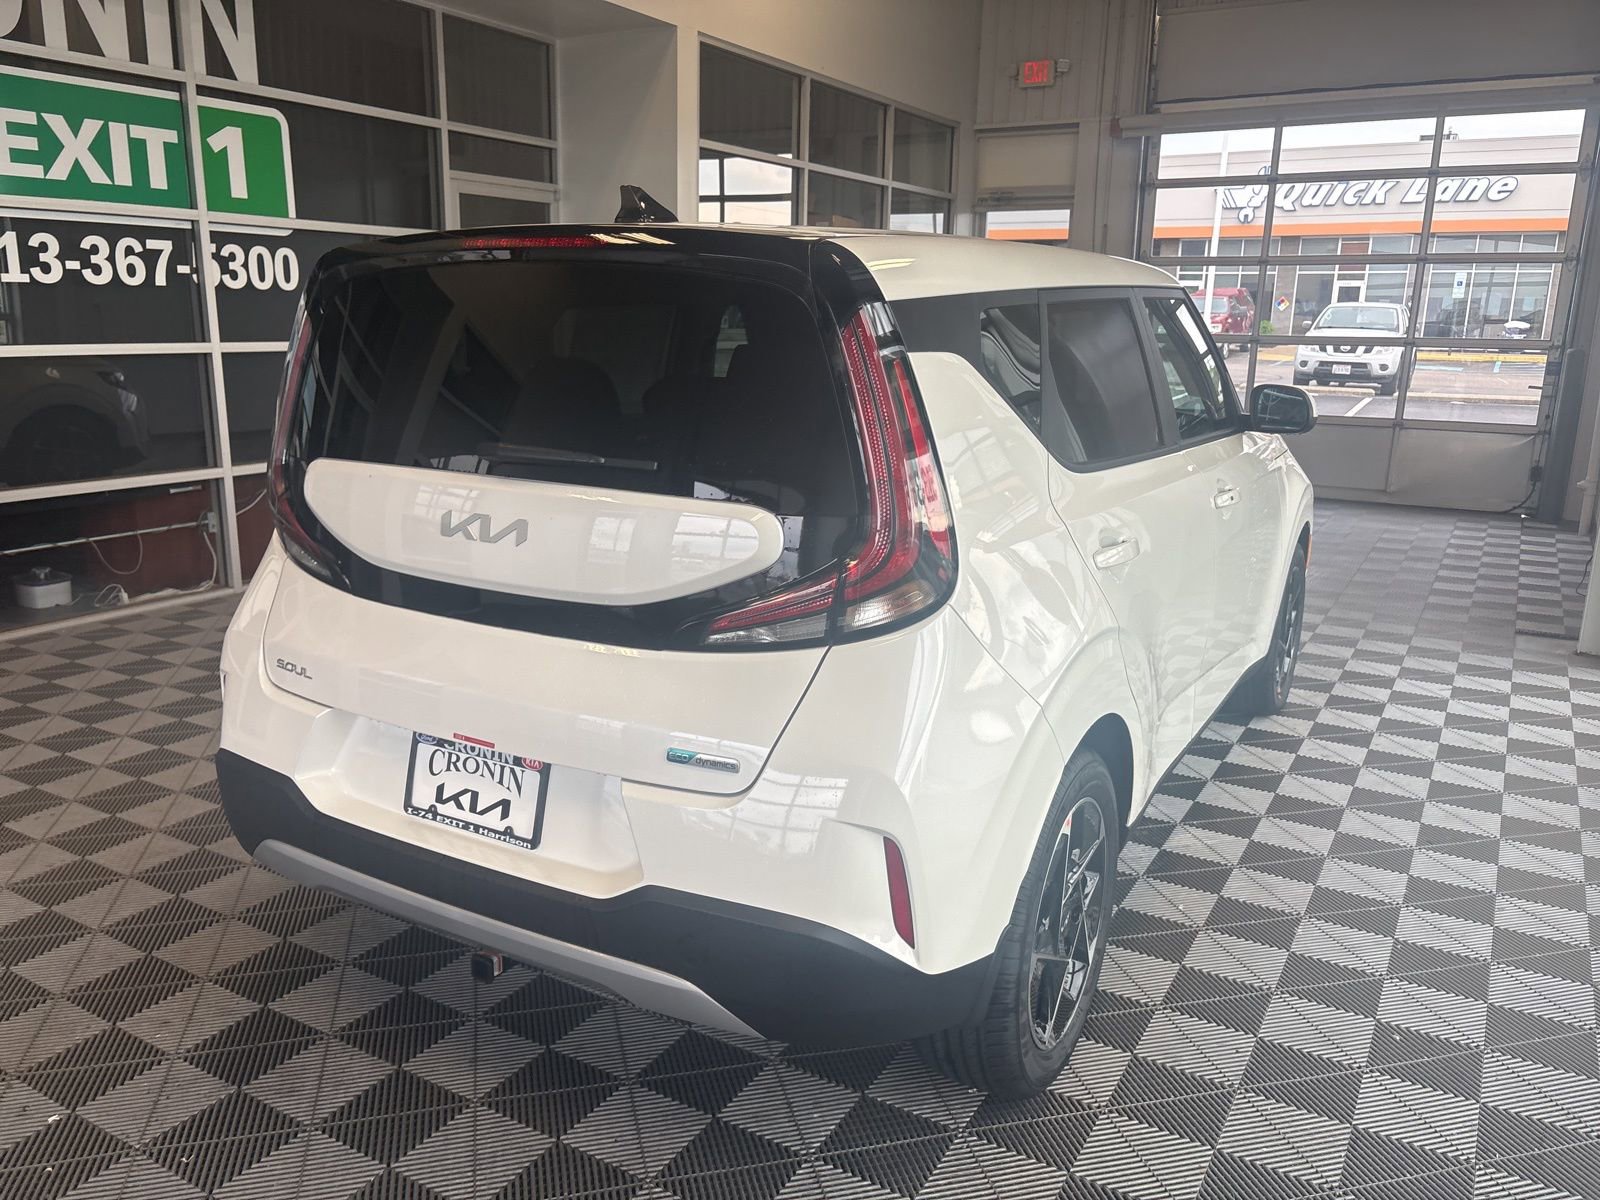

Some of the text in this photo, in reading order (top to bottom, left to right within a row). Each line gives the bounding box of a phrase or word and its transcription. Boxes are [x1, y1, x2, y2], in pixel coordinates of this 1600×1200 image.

[1023, 61, 1050, 84] EXIT
[0, 107, 249, 200] EXIT 1
[1274, 175, 1519, 212] Quick Lane
[440, 509, 529, 548] KIA
[276, 658, 313, 680] SOUL
[428, 748, 526, 799] CRONIN
[668, 751, 737, 771] ECO dynamics
[435, 782, 512, 822] KIA
[407, 807, 532, 849] I-74 EXIT 1 Harrison
